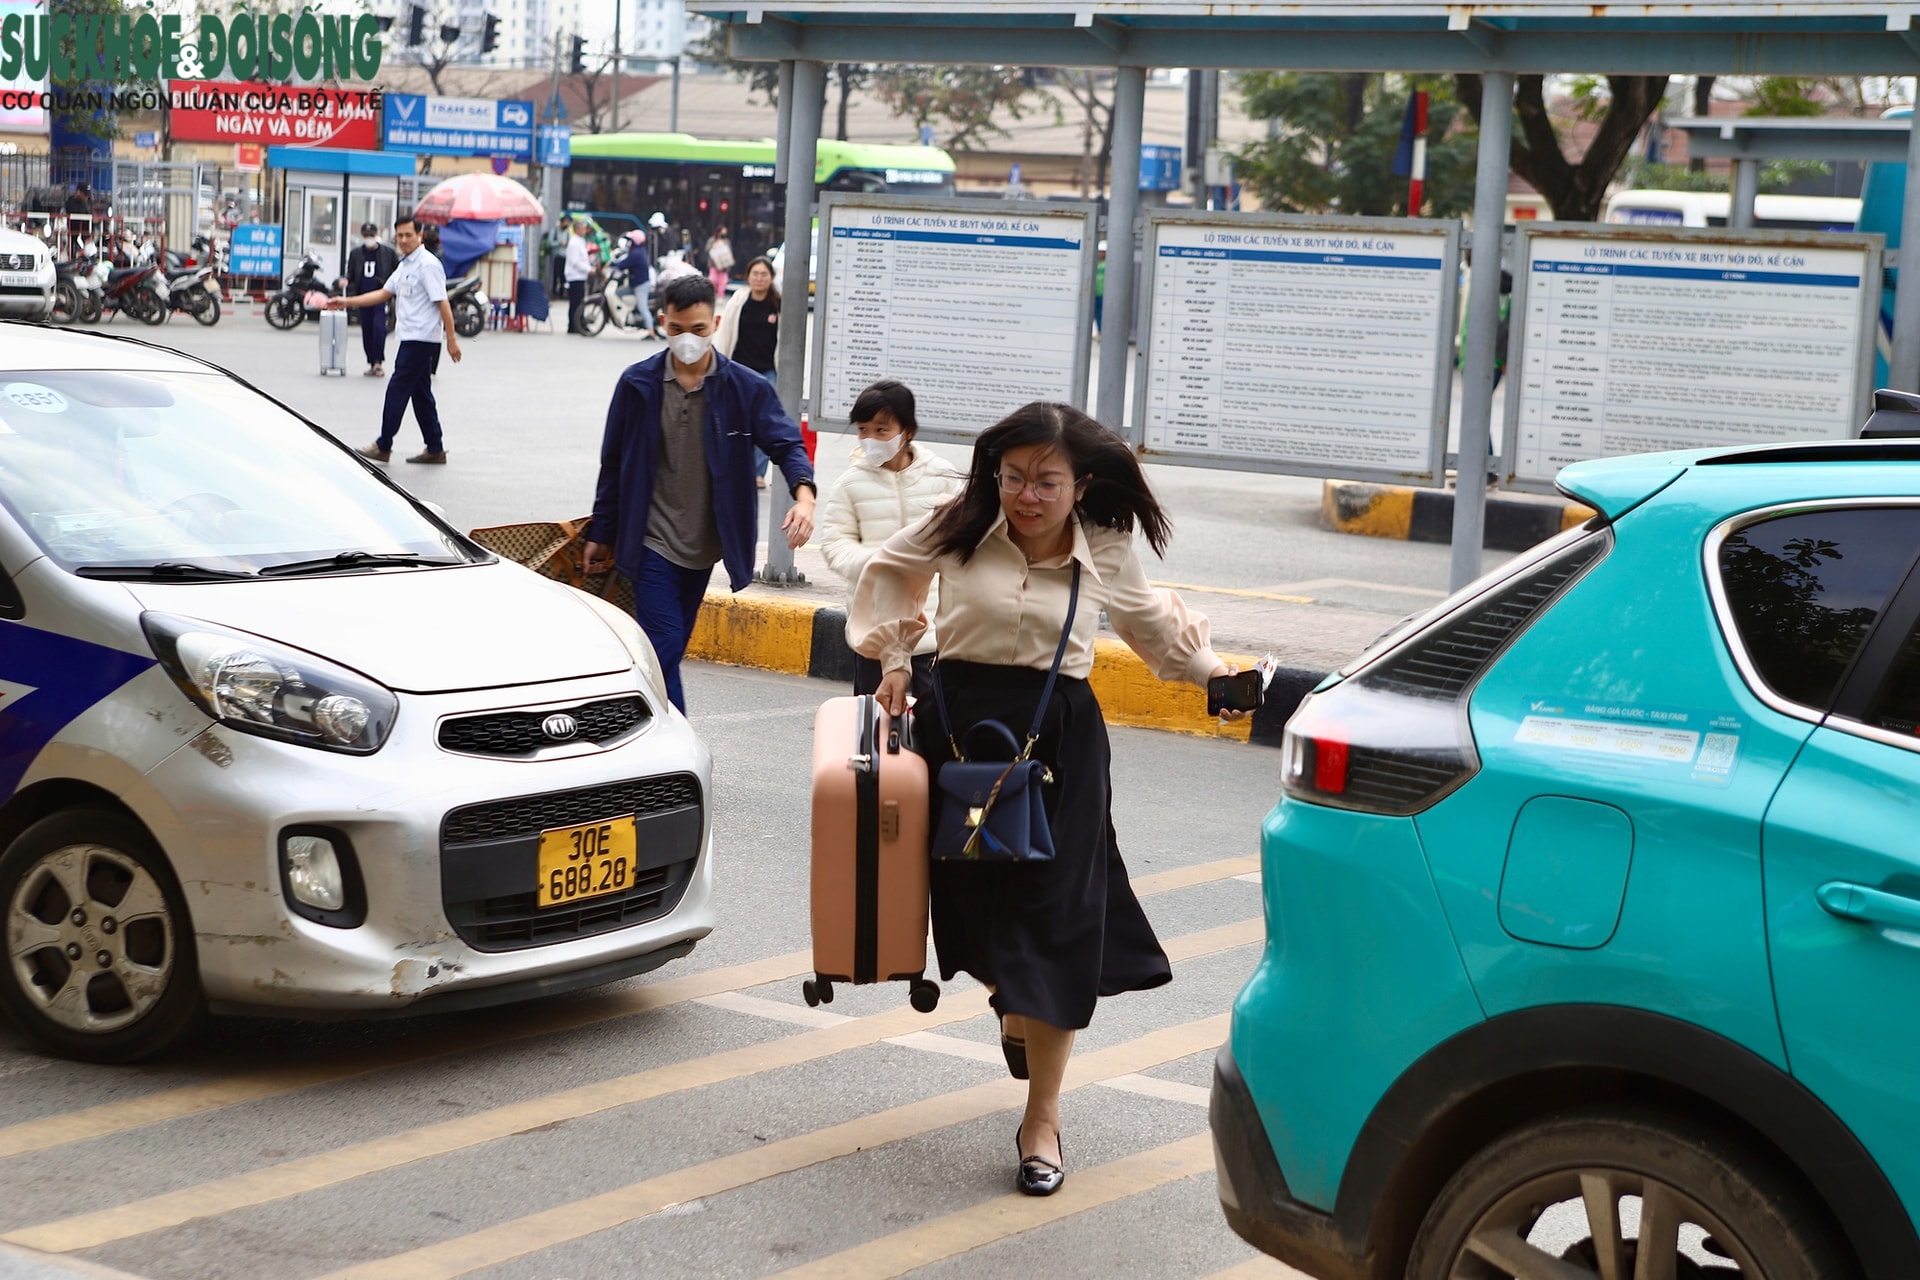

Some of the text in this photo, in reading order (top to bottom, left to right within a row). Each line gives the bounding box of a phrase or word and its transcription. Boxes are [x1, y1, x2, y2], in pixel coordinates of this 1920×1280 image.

[216, 113, 333, 139] NGÀY VÀ ĐÊM
[872, 214, 882, 226] LỘ
[906, 216, 922, 226] CÁC
[924, 214, 946, 227] TUYẾN
[948, 218, 958, 228] XE
[1204, 232, 1214, 244] LỘ
[1243, 234, 1260, 245] CÁC
[1262, 233, 1288, 246] TUYẾN
[1290, 238, 1302, 246] XE
[1584, 246, 1596, 259] LỘ
[1629, 248, 1648, 259] CÁC
[1652, 247, 1681, 260] TUYẾN
[1685, 252, 1696, 262] XE
[364, 262, 376, 278] U
[1650, 710, 1668, 720] TAXI
[1668, 712, 1689, 722] FARE
[548, 718, 575, 734] KIA
[568, 824, 612, 860] 30E
[550, 857, 626, 900] 688.28
